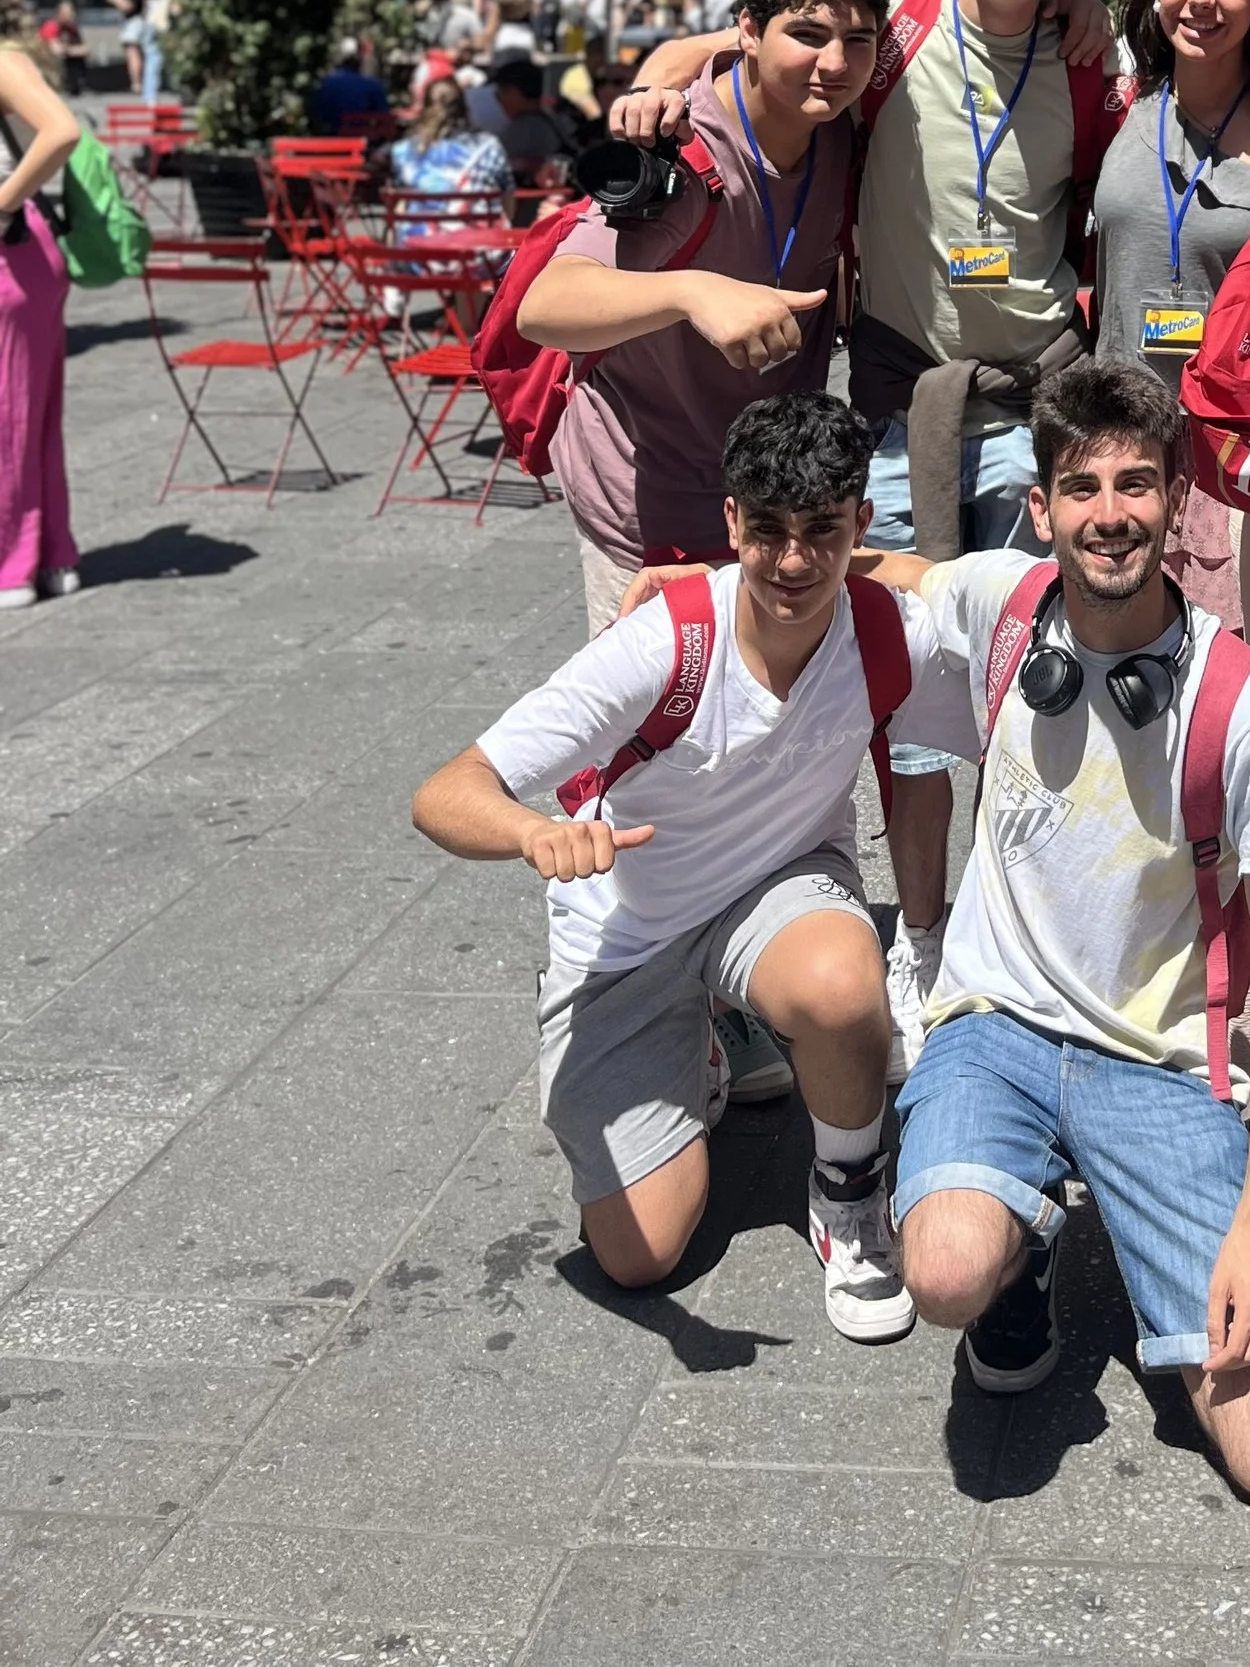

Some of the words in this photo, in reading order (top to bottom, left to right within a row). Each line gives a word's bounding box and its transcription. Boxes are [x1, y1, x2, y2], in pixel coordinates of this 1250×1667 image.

[881, 18, 919, 70] KINGDOM
[950, 250, 1006, 277] MetroCard
[1144, 316, 1201, 340] MetroCard
[675, 622, 692, 693] LANGUAGE
[684, 622, 702, 694] KINGDOM
[992, 618, 1026, 686] KINGDOM
[1032, 664, 1054, 686] JBL
[1003, 757, 1040, 791] ATHLETIC
[1040, 790, 1067, 810] CLUB
